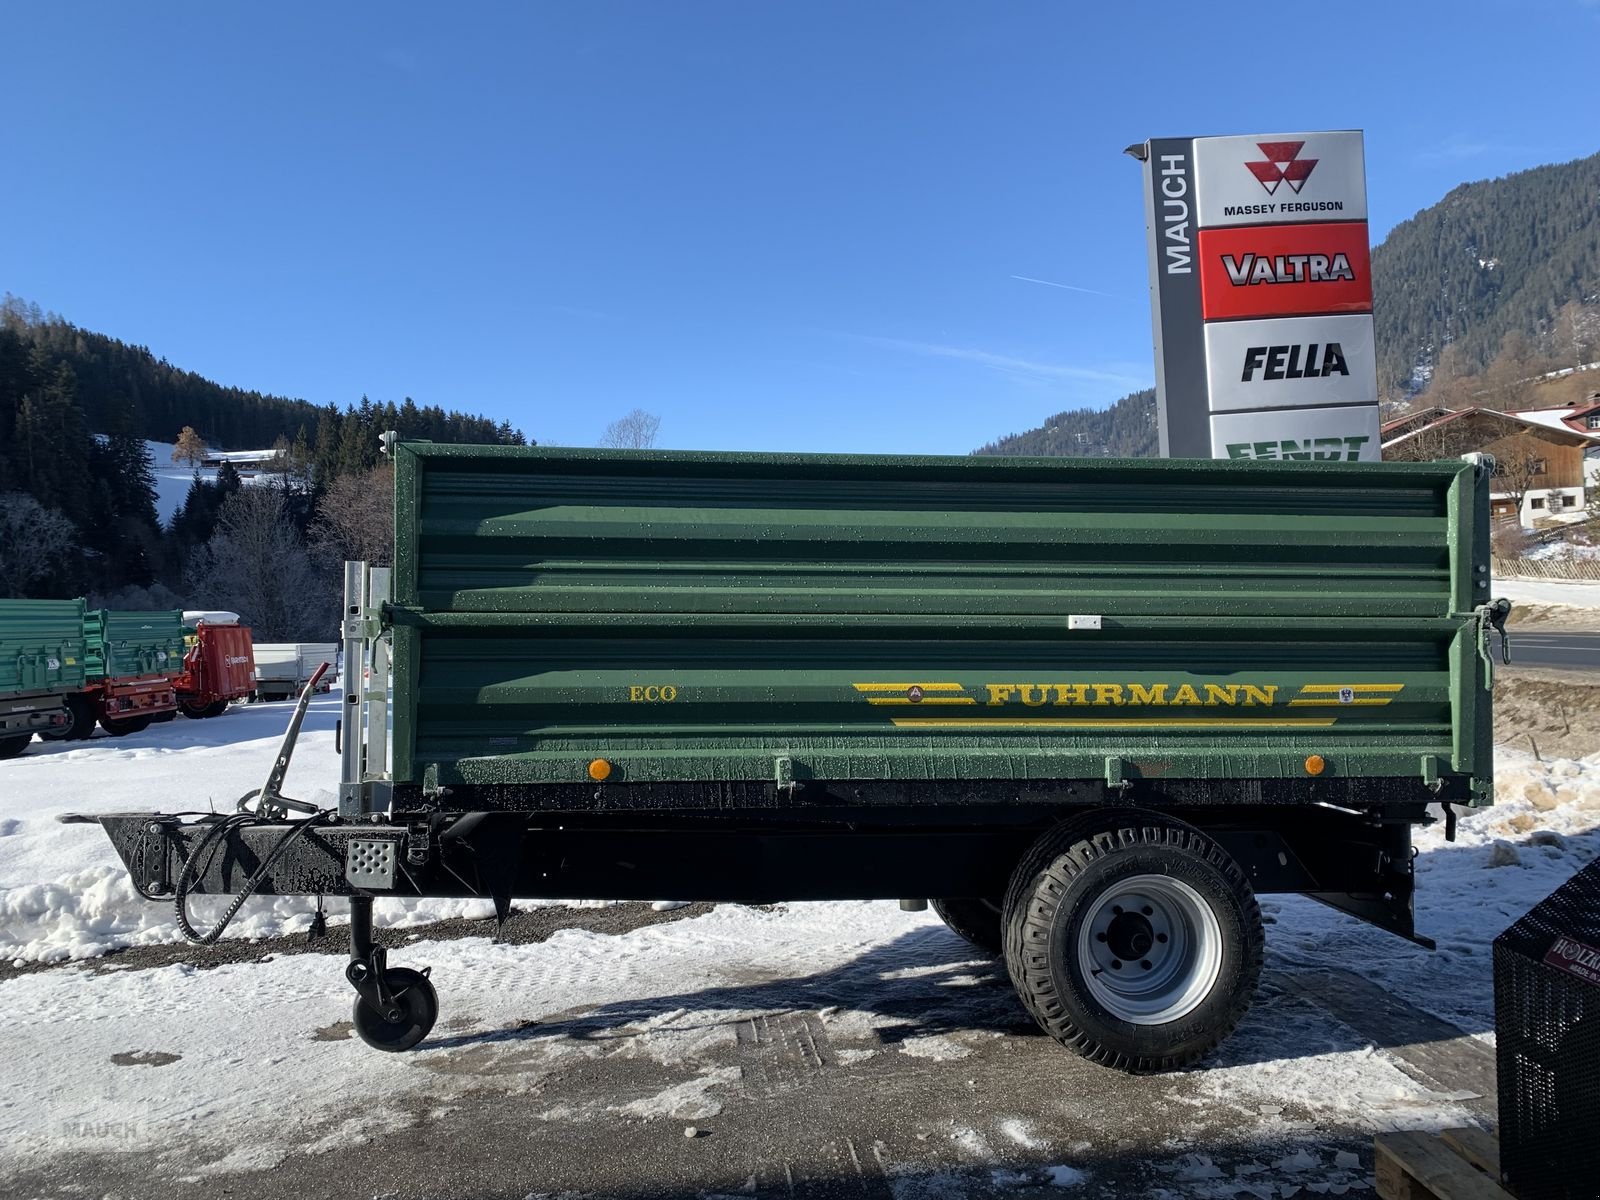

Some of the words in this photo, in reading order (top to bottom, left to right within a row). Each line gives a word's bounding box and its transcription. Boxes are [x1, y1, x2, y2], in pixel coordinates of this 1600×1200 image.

[1161, 154, 1192, 274] MAUCH
[1224, 204, 1276, 216] MASSEY
[1280, 201, 1343, 213] FERGUSON
[1220, 253, 1356, 287] VALTRA
[1241, 343, 1350, 382] FELLA
[629, 685, 677, 702] ECO
[985, 684, 1278, 707] FUHRMANN
[1552, 938, 1600, 972] HOLZK
